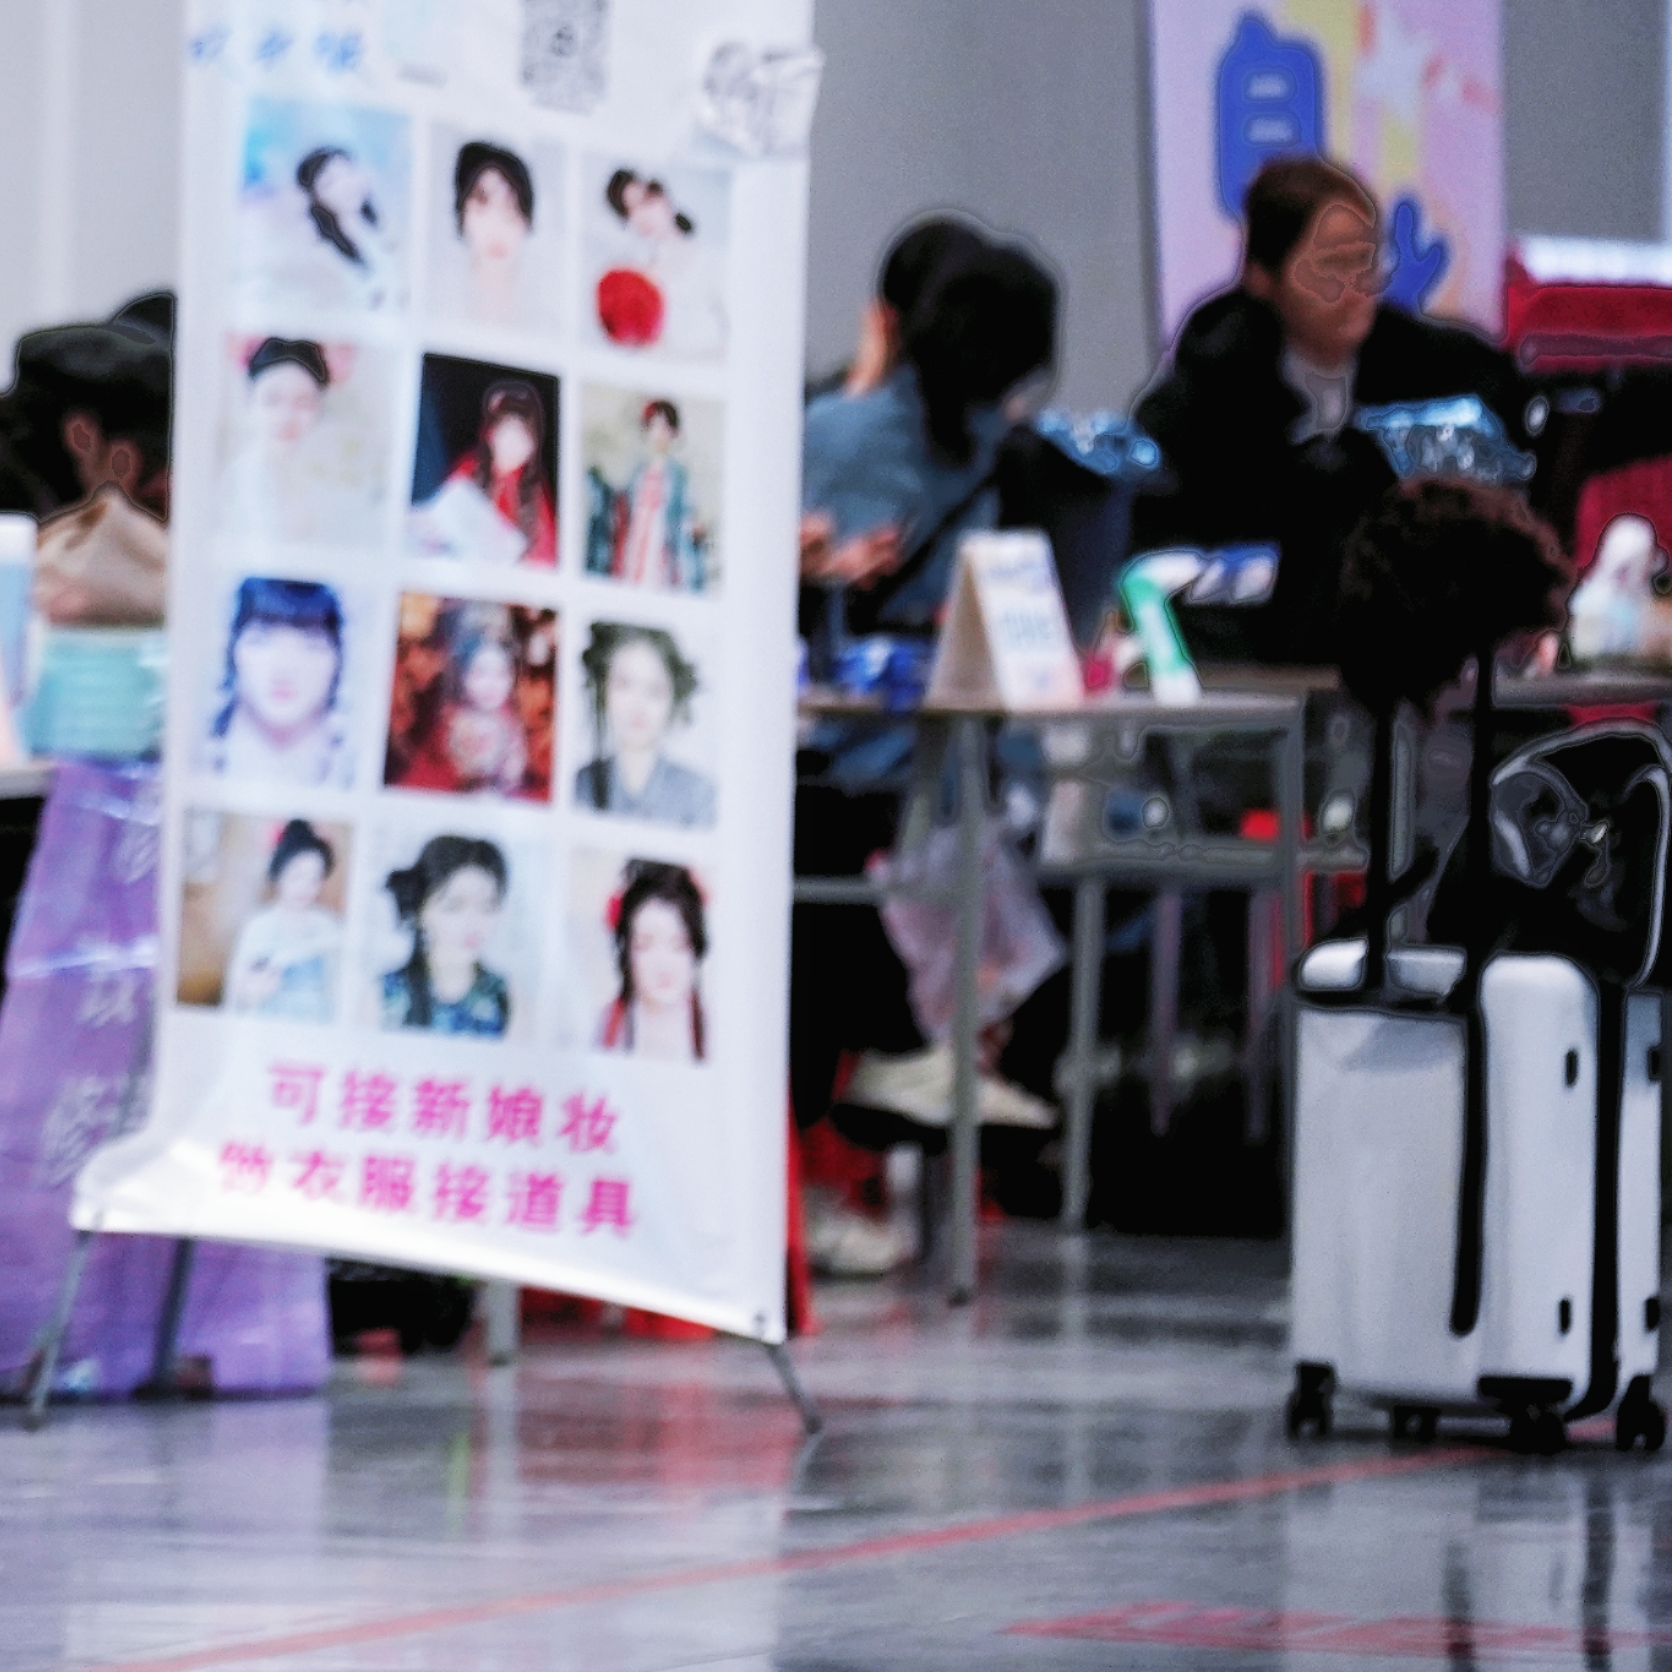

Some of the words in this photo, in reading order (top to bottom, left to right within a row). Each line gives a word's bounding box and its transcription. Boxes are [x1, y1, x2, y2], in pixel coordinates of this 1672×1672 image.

[269, 1061, 617, 1153] 可接新娘妆
